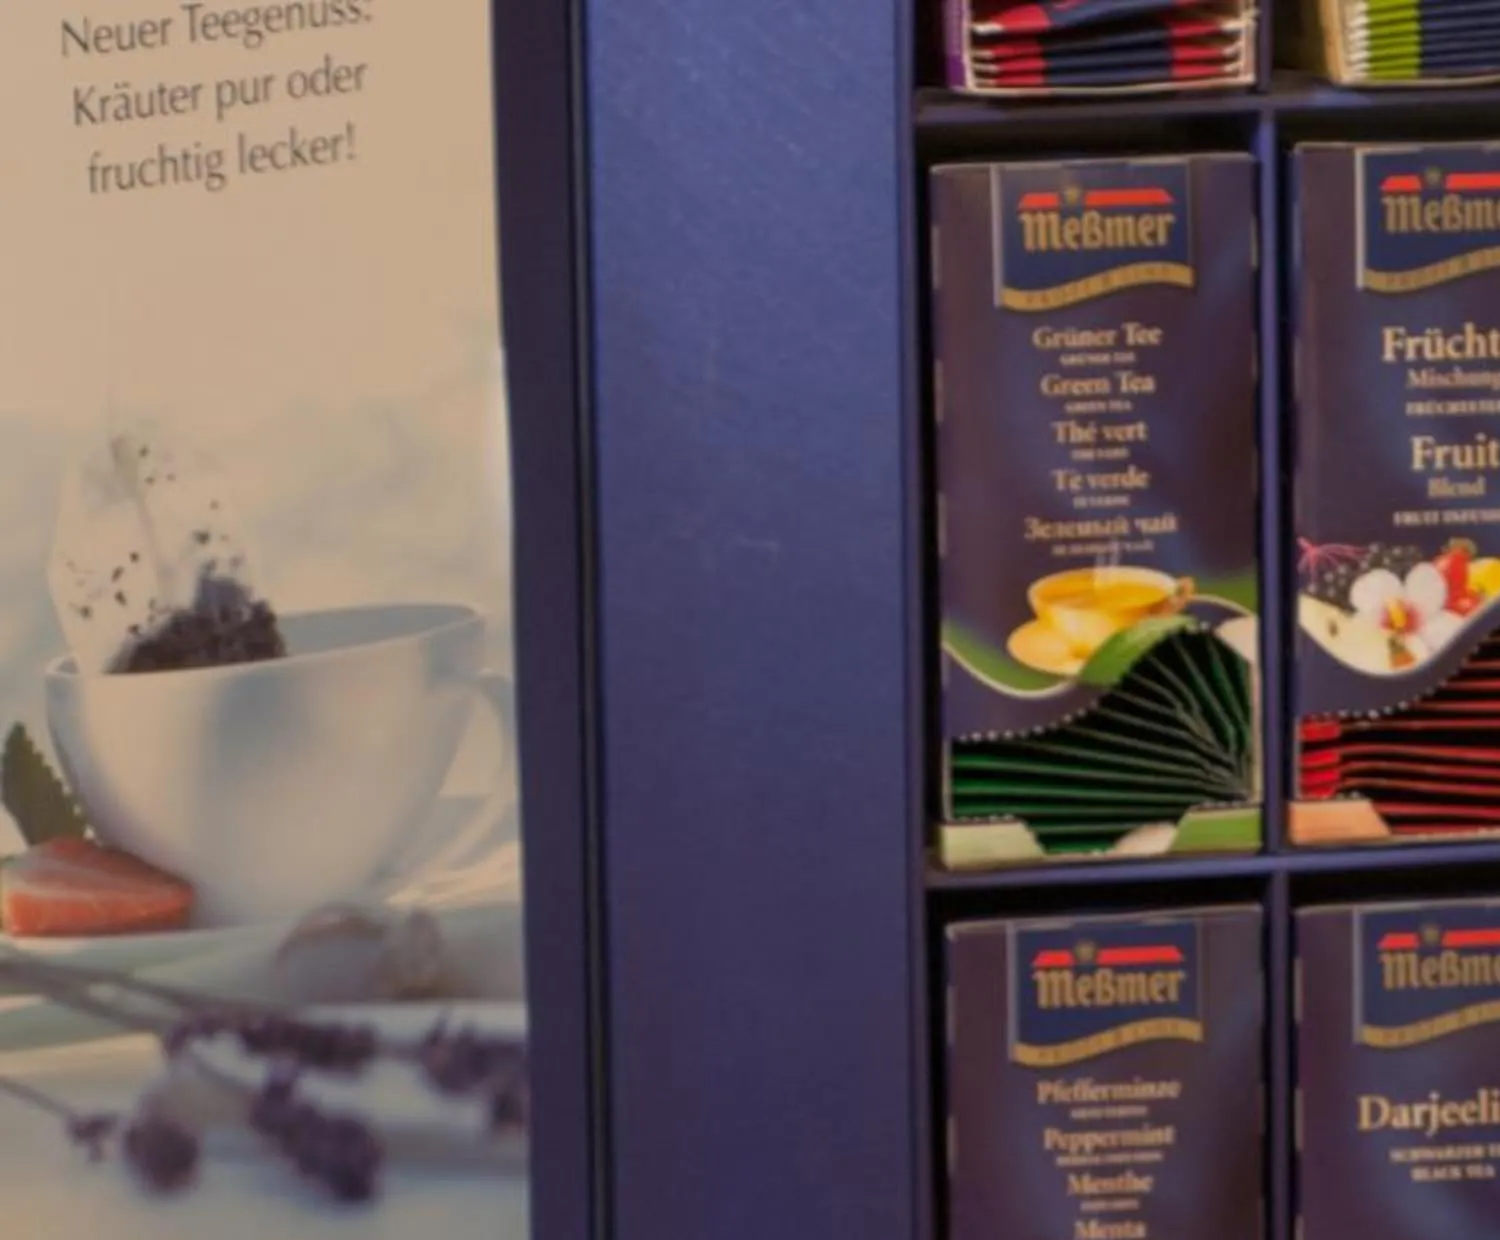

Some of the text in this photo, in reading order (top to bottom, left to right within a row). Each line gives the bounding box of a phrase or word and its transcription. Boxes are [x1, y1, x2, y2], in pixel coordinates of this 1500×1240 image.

[61, 16, 172, 57] Neuer
[73, 53, 368, 127] Kräuter pur oder
[88, 121, 357, 194] fruchtig lecker!
[1018, 210, 1177, 252] Meßmer
[1040, 369, 1156, 397] Green Tea
[1427, 475, 1486, 498] Blend
[1032, 968, 1187, 1009] Meßmer
[1044, 1125, 1177, 1154] Peppermint
